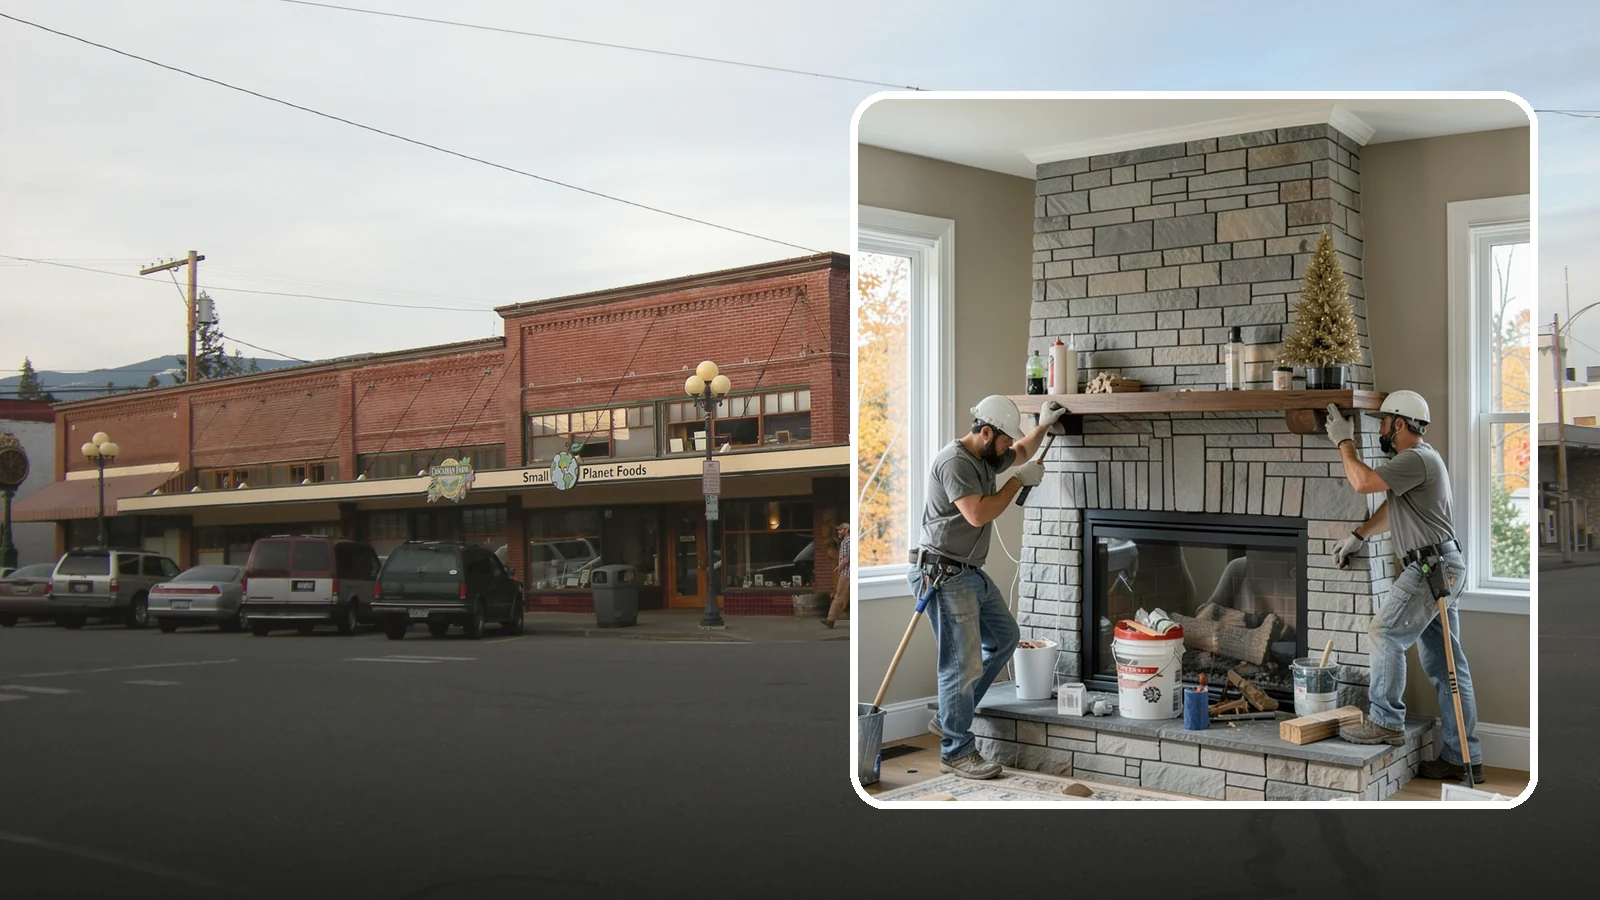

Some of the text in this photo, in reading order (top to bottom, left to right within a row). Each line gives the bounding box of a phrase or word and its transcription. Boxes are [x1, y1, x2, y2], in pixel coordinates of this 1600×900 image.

[523, 464, 647, 483] Small Planet Foods
